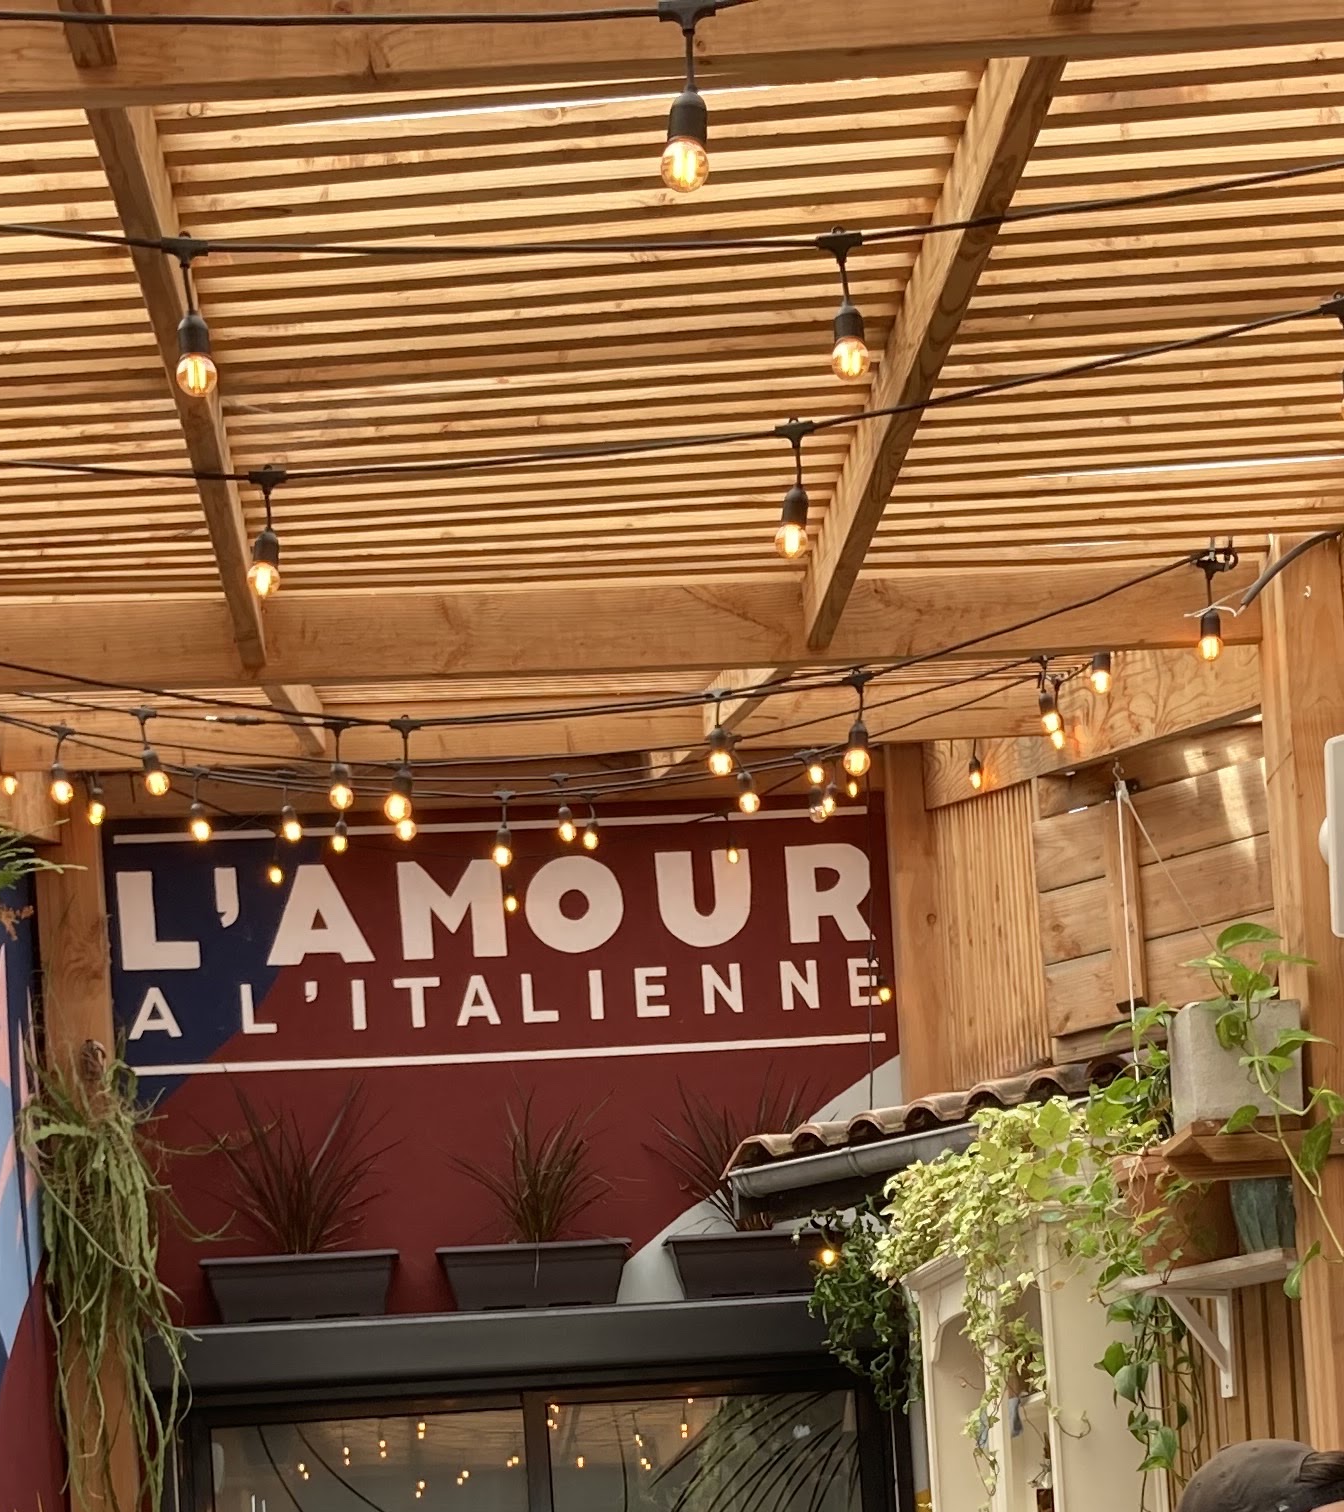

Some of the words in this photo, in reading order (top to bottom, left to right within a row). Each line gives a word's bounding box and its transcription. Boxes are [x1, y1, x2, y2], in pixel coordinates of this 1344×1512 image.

[114, 843, 875, 971] L'AMOUR
[129, 986, 183, 1042] A
[240, 956, 884, 1036] L'ITALIENNE
